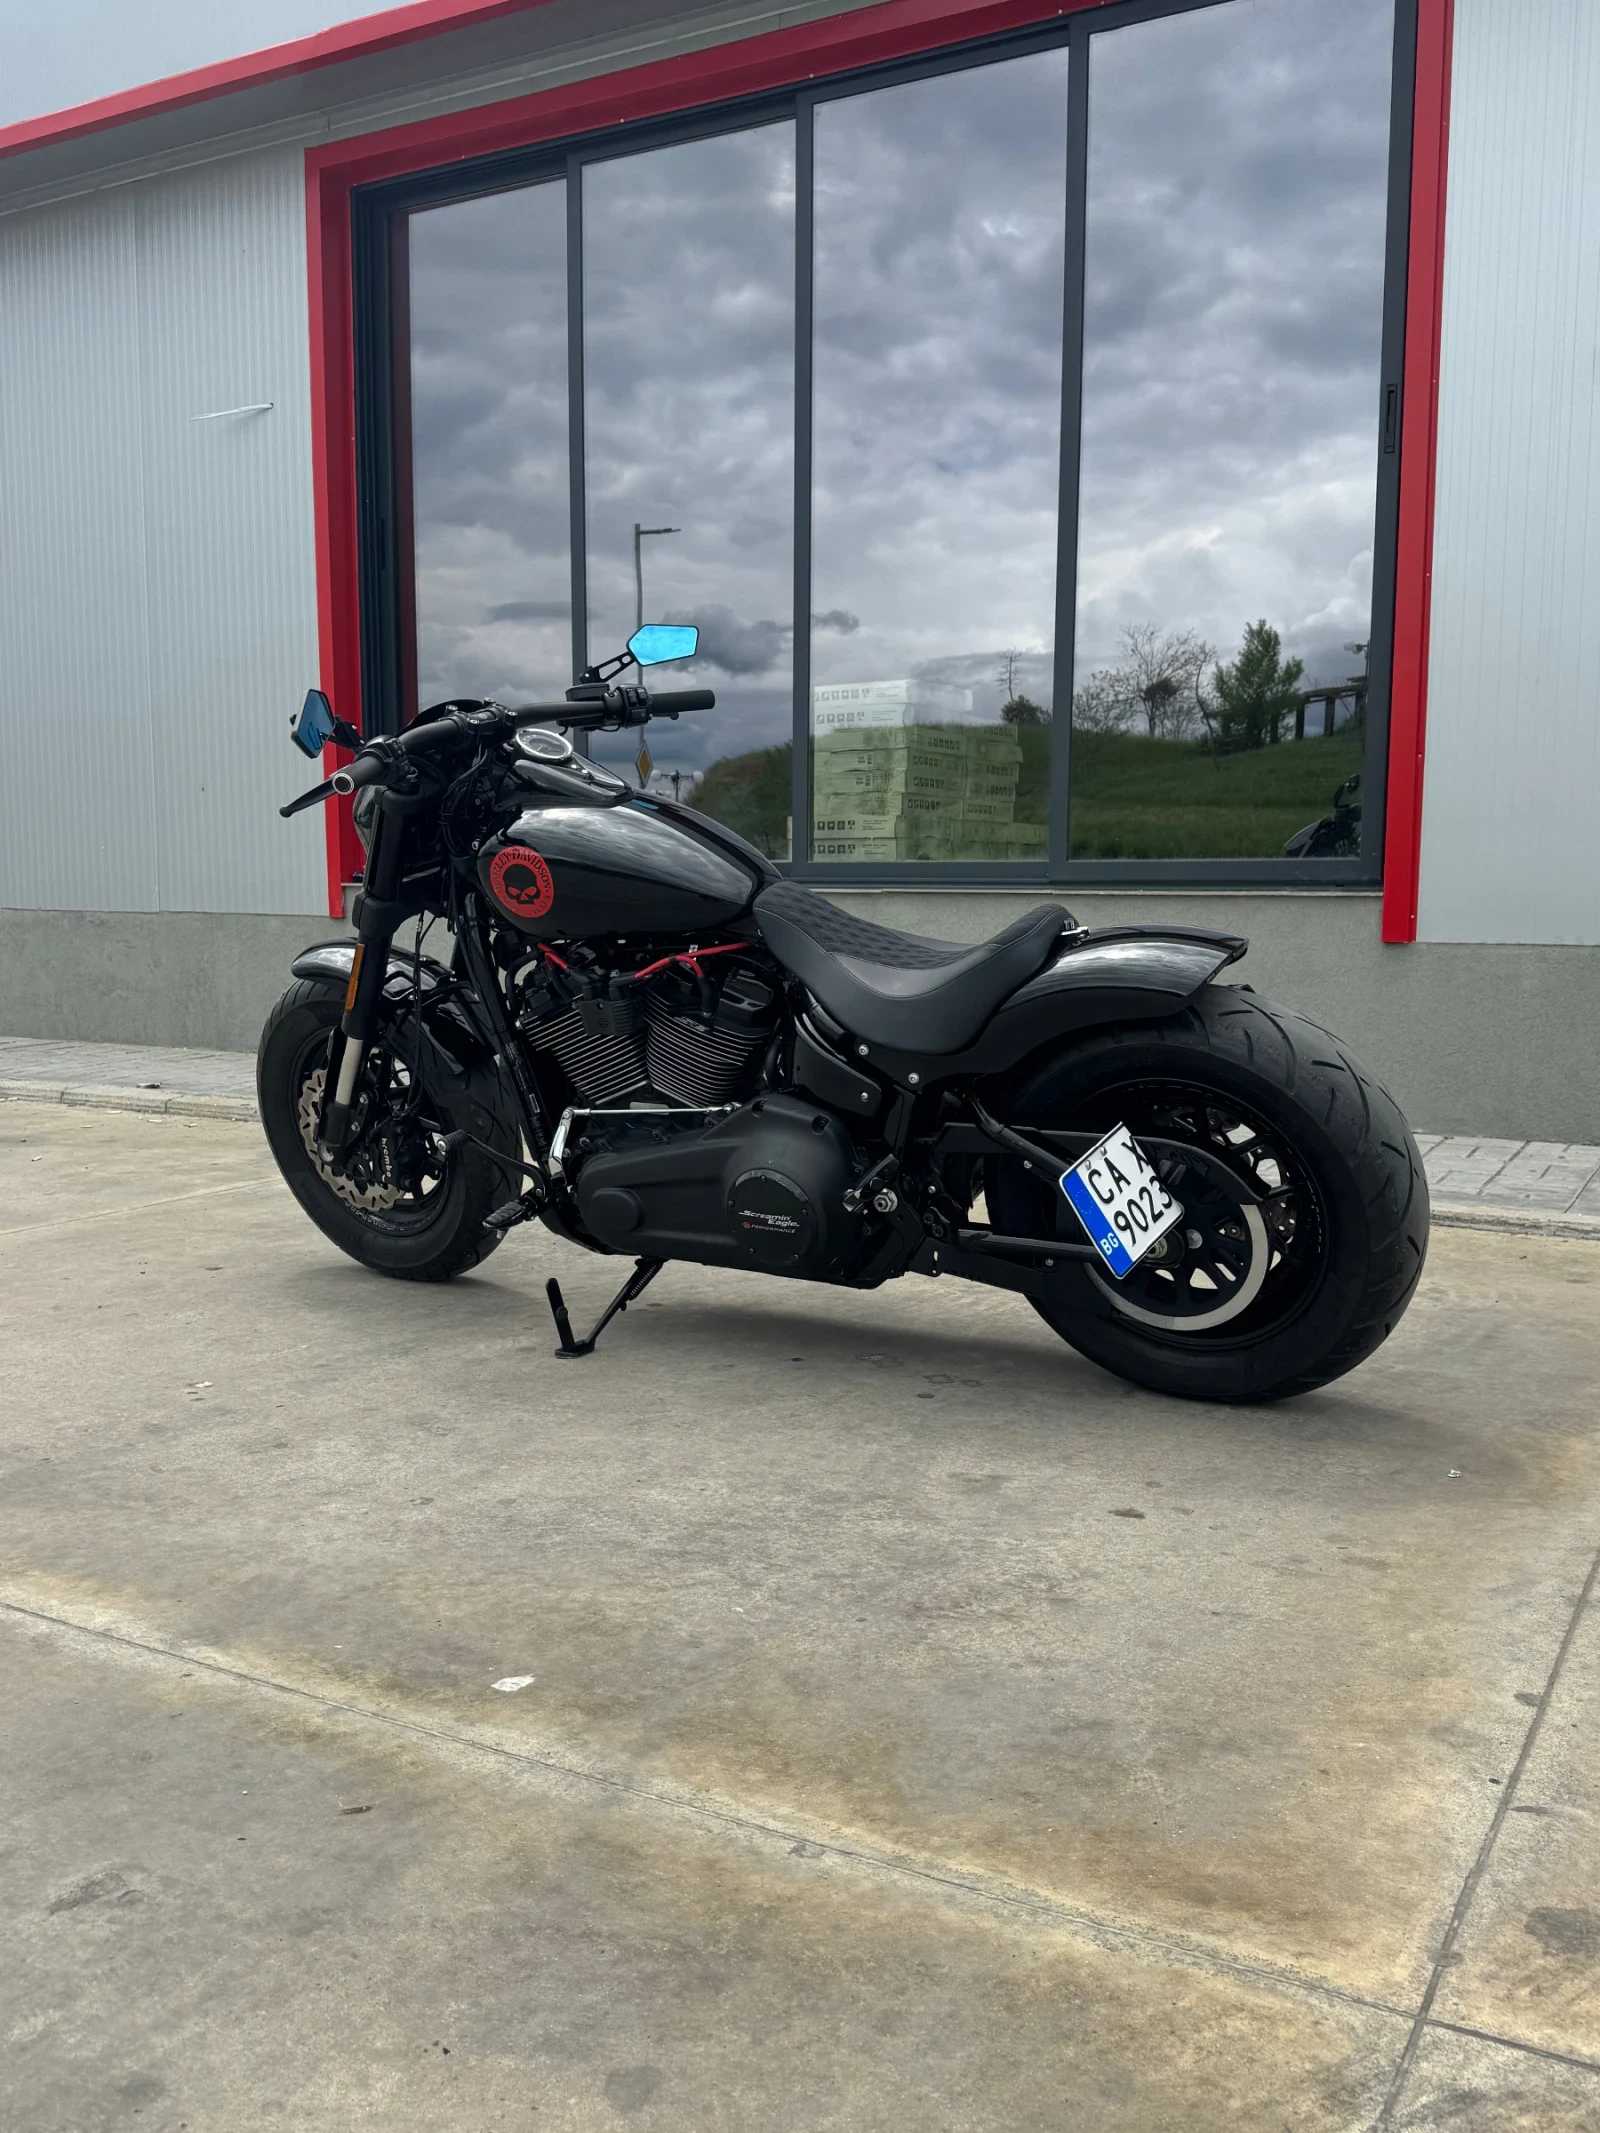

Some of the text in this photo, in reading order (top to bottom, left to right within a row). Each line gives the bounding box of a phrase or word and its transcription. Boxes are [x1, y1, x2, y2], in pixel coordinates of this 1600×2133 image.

[381, 1137, 393, 1178] brembo
[1087, 1135, 1150, 1204] CA X
[768, 1219, 800, 1227] Eagle
[1113, 1175, 1173, 1247] 9023
[751, 1224, 796, 1233] PERFORMANCE
[1100, 1232, 1119, 1255] BG
